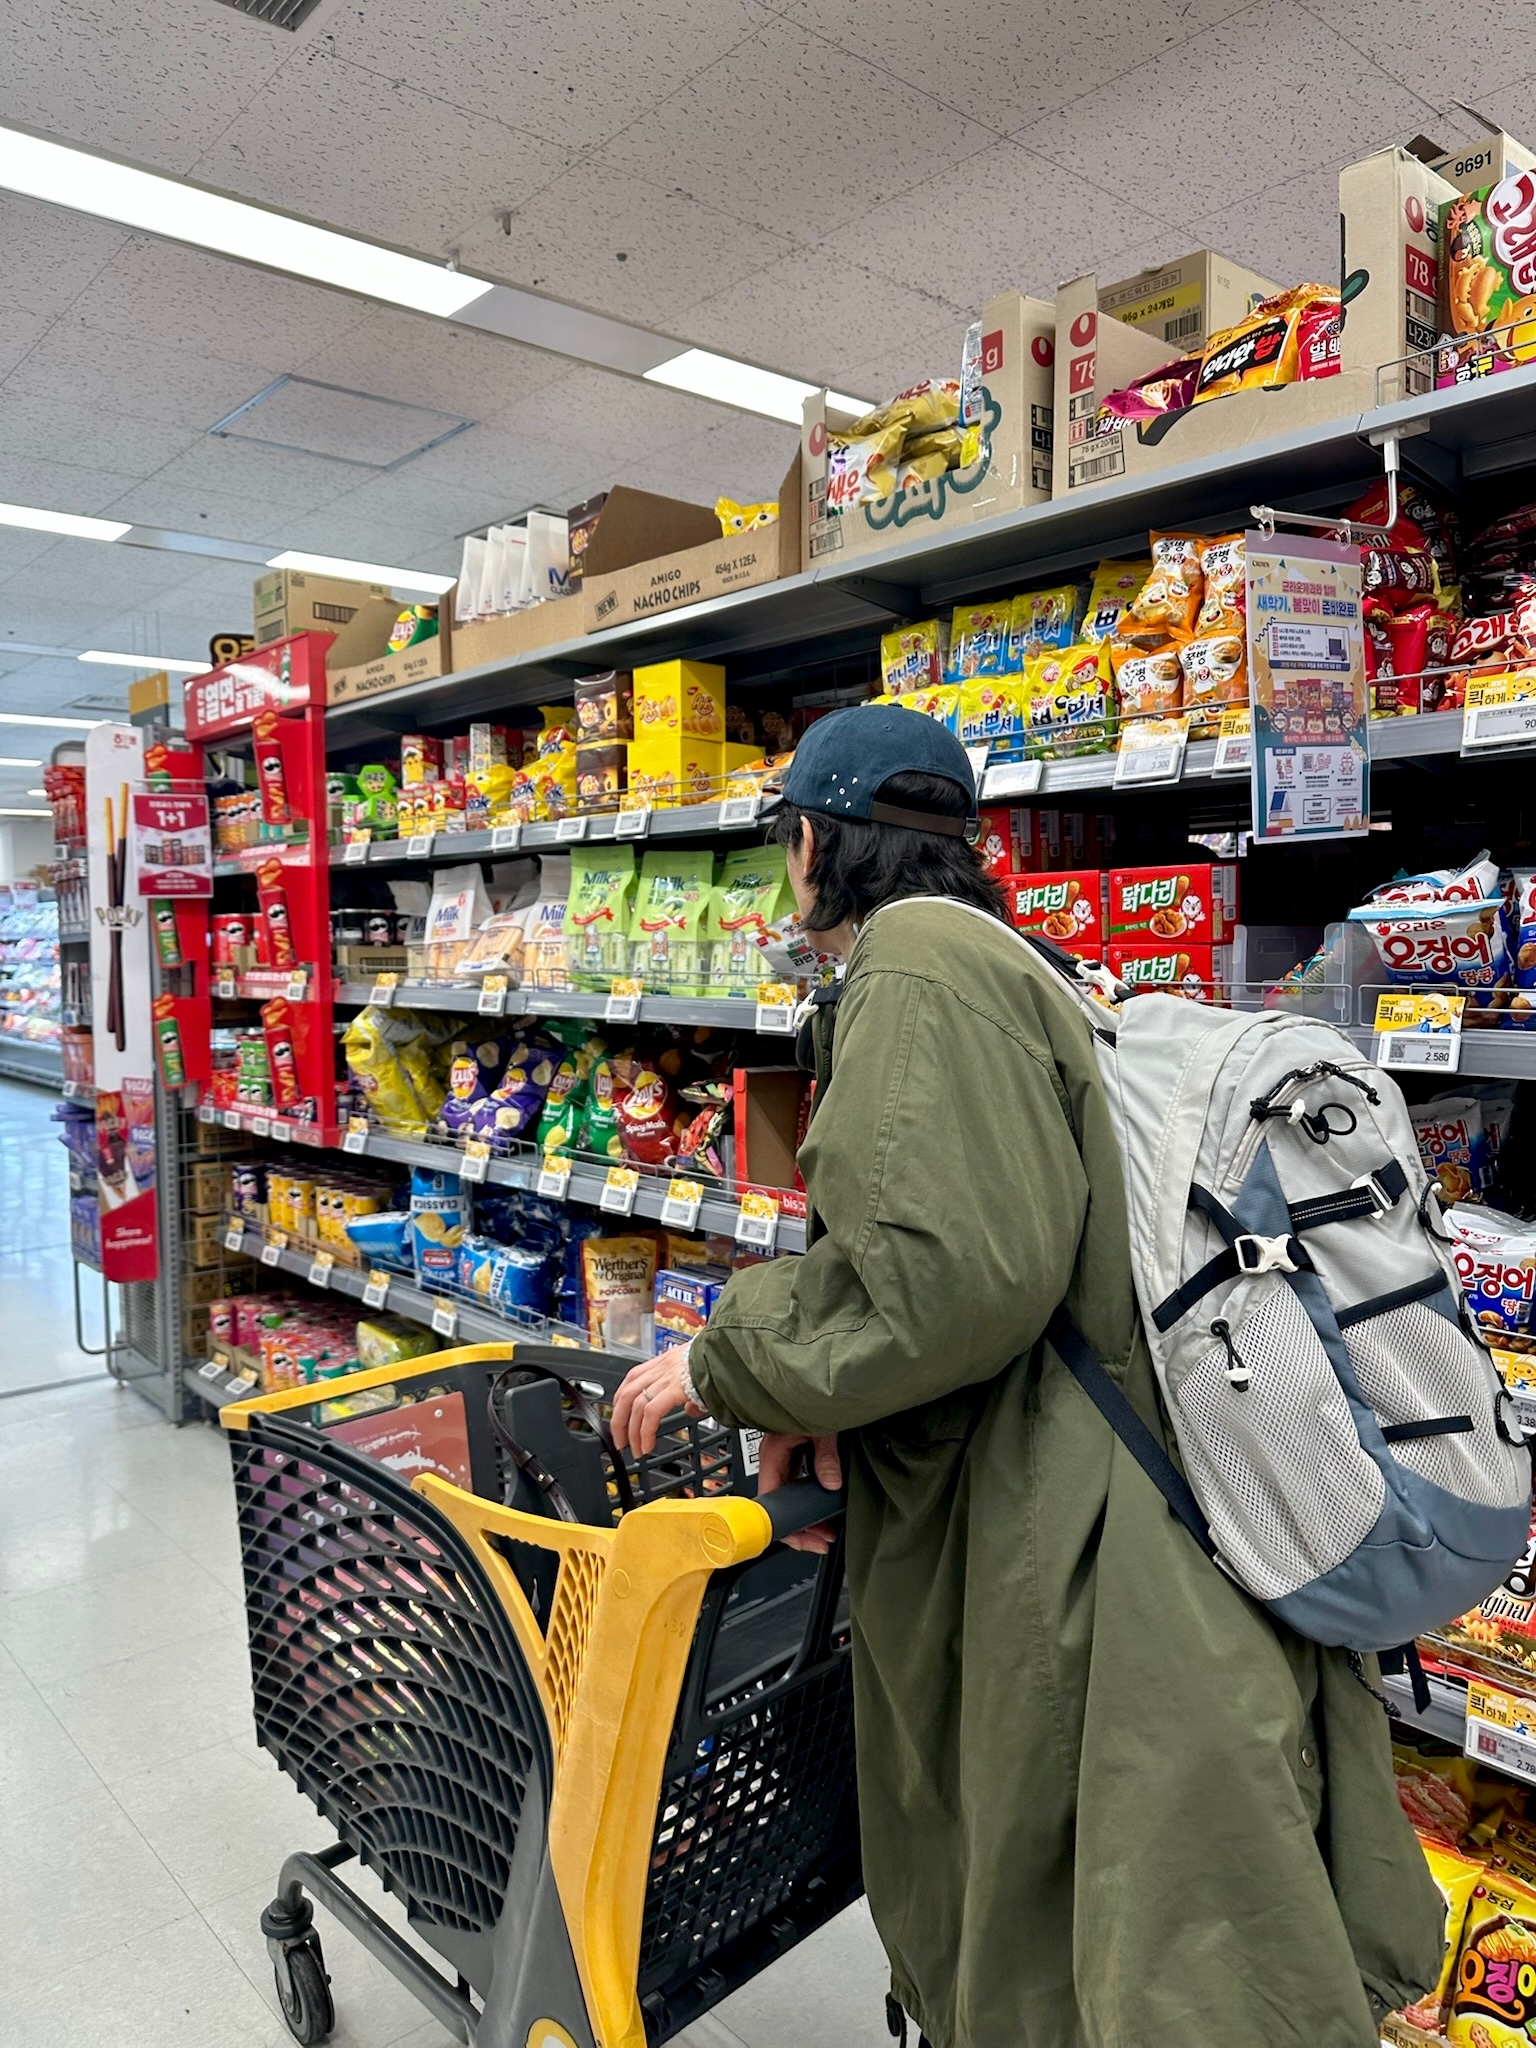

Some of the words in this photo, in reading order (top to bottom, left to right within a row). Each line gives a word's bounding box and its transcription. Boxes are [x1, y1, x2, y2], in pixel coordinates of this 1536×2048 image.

[1454, 150, 1493, 177] 9691
[1408, 253, 1430, 287] 78
[986, 346, 999, 370] g
[1203, 331, 1282, 383] 인디안밥
[1309, 339, 1327, 363] 별
[714, 560, 732, 575] 454g
[739, 553, 757, 568] 12EA
[650, 569, 681, 587] AMIGO
[1282, 580, 1323, 597] 크라운제과와
[598, 599, 616, 616] NEW
[633, 590, 670, 612] NACHO
[672, 580, 701, 601] CHIPS
[1256, 594, 1291, 614] 새학기,
[1292, 597, 1321, 615] 봄맞이
[1322, 600, 1358, 619] 준비완료!
[886, 650, 930, 684] 미니뿌셔
[961, 709, 1014, 740] 미니뿌셔
[156, 810, 186, 828] 1+1
[583, 871, 611, 885] Milk
[1015, 881, 1069, 916] 닭다리
[1121, 875, 1178, 913] 닭다리
[434, 905, 459, 922] Milk
[1396, 920, 1447, 933] 오리온
[1383, 931, 1490, 973] 오징어
[1120, 953, 1178, 986] 닭다리
[1458, 966, 1495, 986] 땅콩
[627, 1080, 664, 1110] Lay's
[625, 1123, 645, 1134] Spicy
[1412, 1119, 1470, 1156] 징어
[591, 1257, 649, 1271] Werther's
[1454, 1251, 1535, 1300] 오징어
[604, 1270, 647, 1283] Original
[599, 1287, 642, 1296] POPCORN
[665, 1287, 681, 1301] ACT
[1486, 1891, 1515, 1911] 농심
